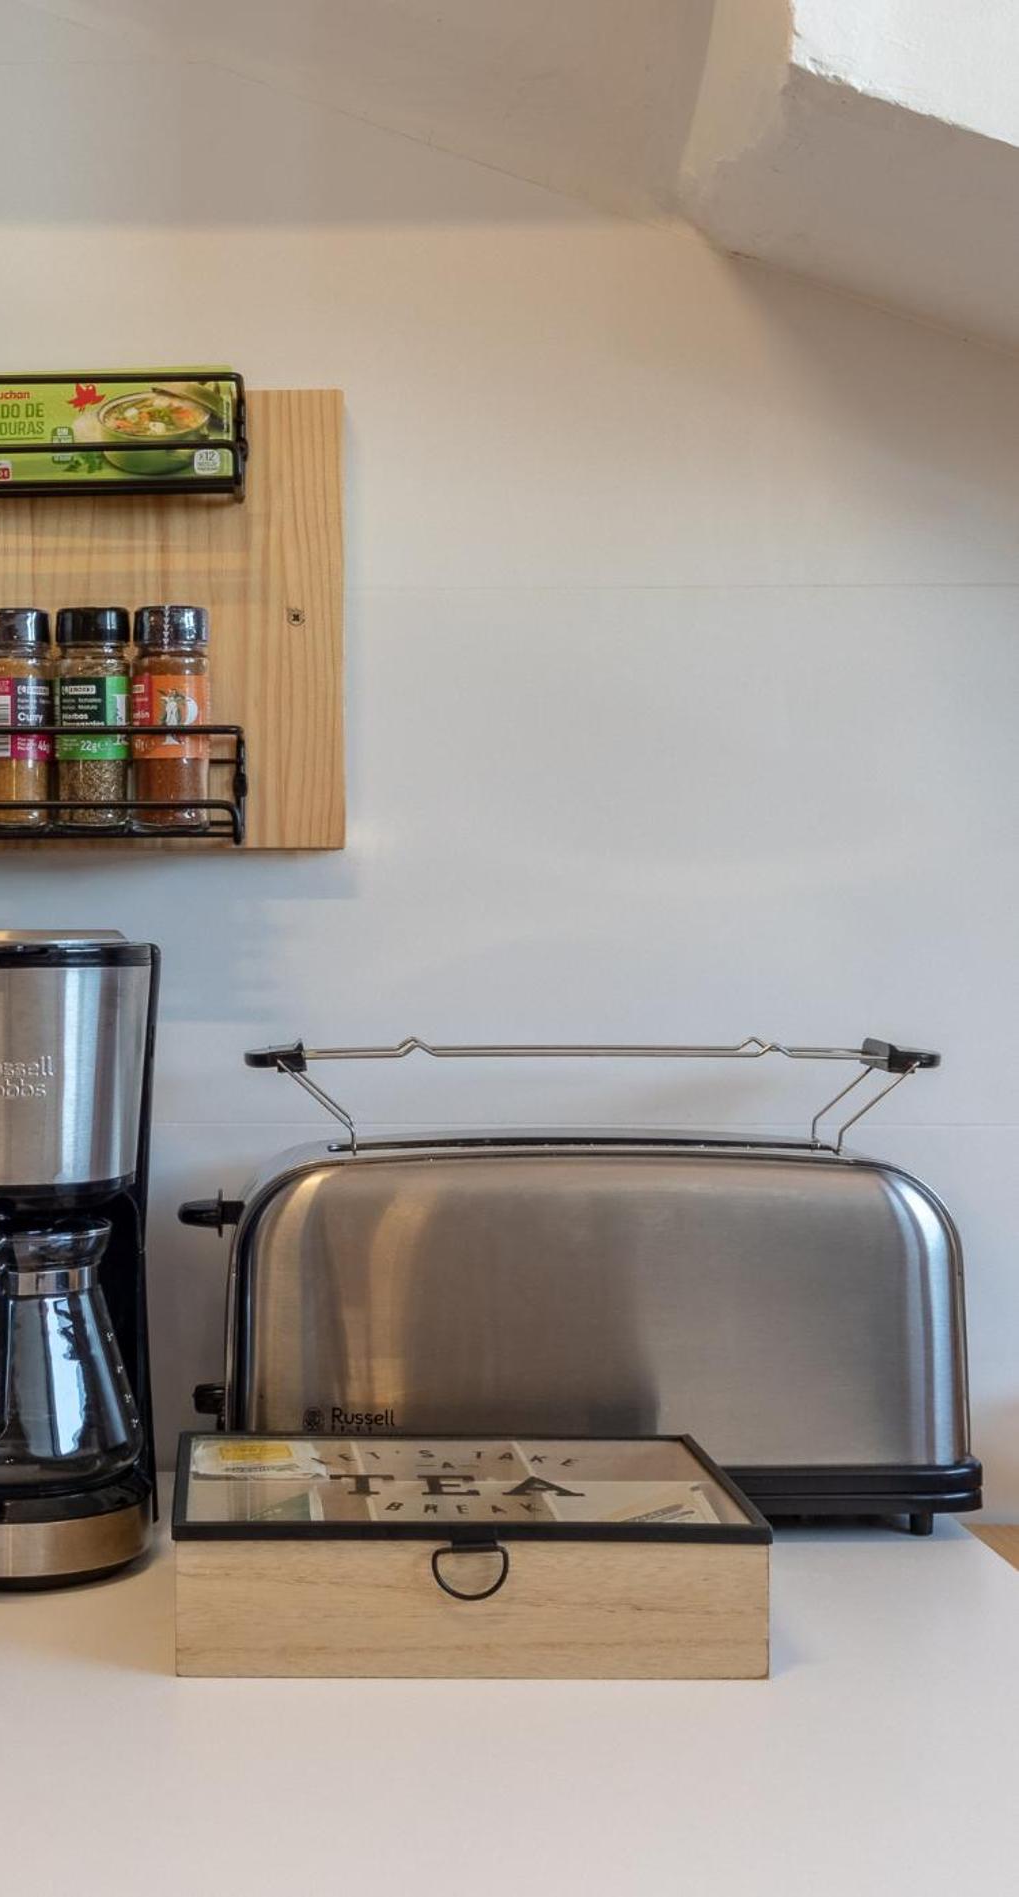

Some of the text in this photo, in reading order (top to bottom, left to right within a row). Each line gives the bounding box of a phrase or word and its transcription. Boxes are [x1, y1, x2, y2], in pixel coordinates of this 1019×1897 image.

[25, 402, 45, 418] DE
[80, 740, 98, 754] 22g
[331, 1406, 396, 1426] Russell
[475, 1449, 579, 1467] TAKE
[328, 1473, 586, 1497] TEA
[384, 1501, 547, 1515] BREAK
